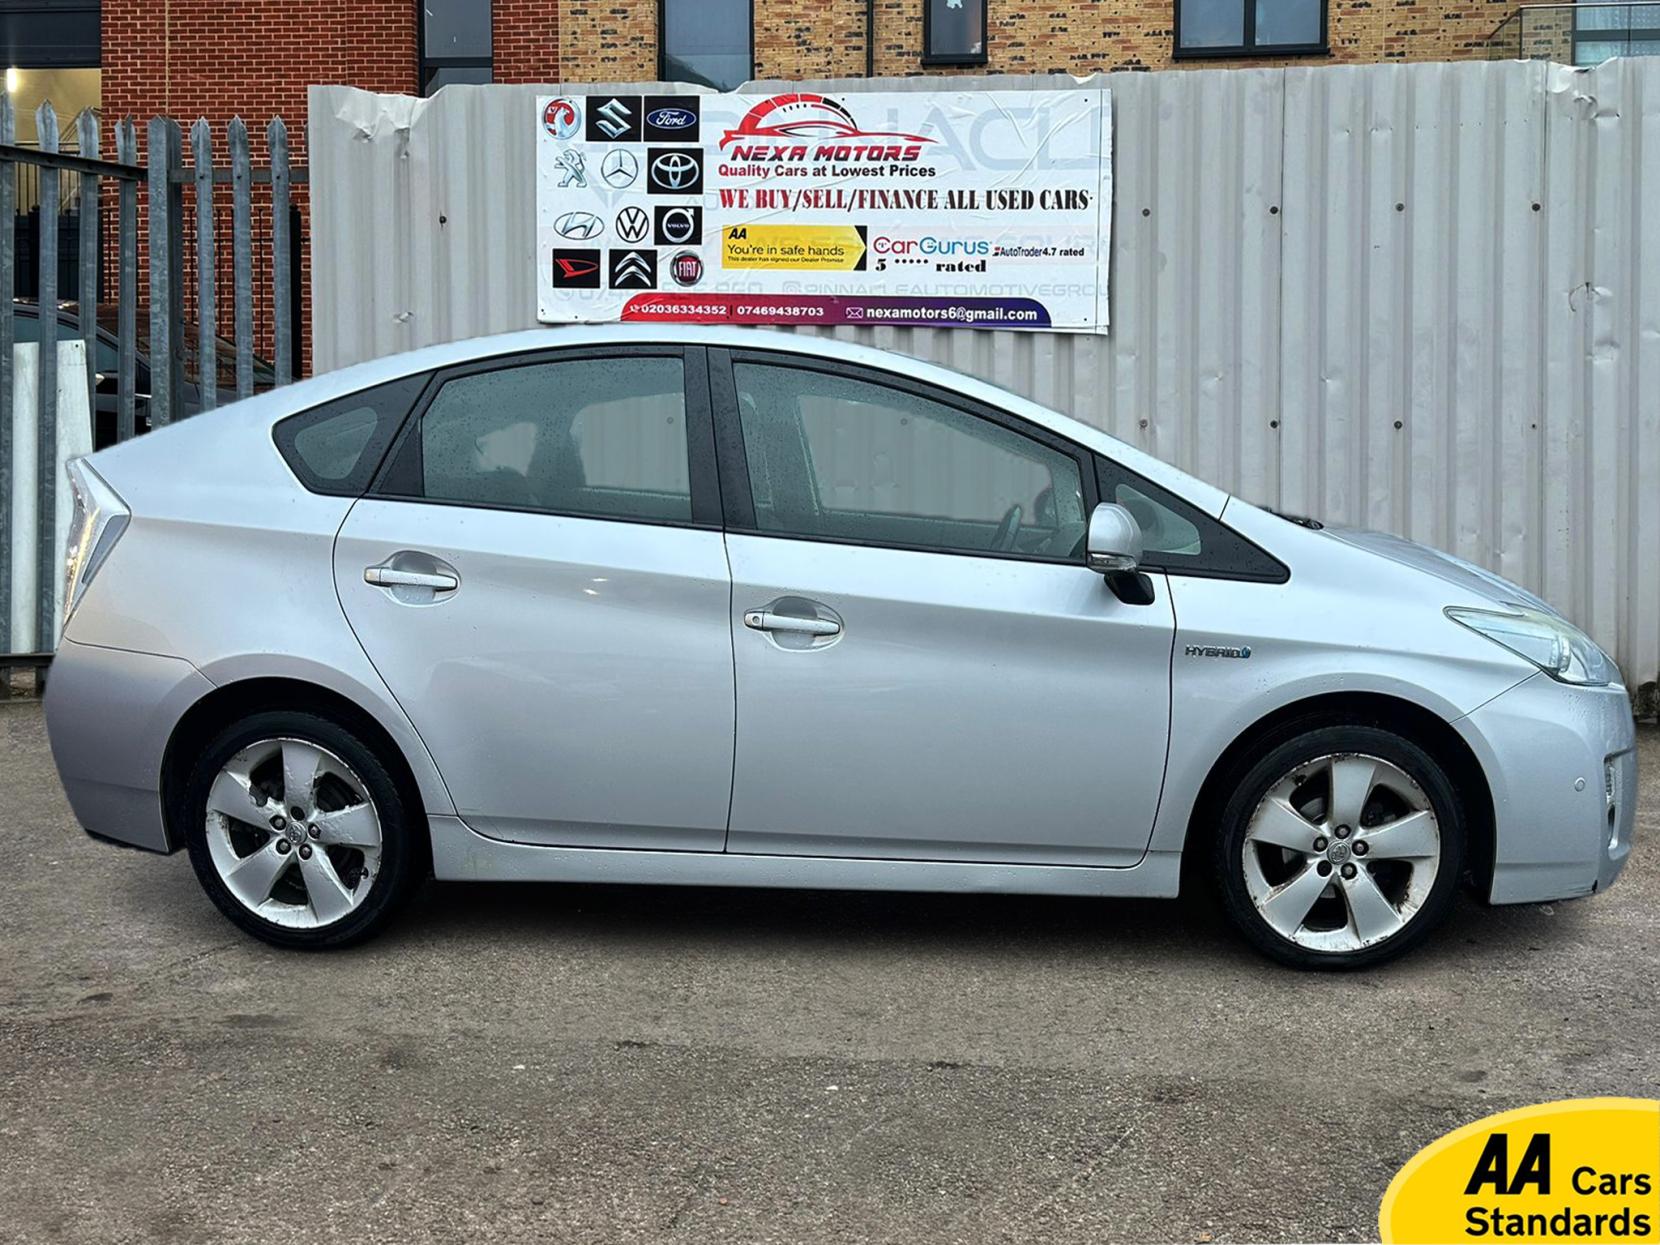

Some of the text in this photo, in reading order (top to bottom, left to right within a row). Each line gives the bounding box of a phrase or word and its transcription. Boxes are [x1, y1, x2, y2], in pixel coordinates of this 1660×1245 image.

[656, 110, 687, 126] Ford
[731, 146, 922, 161] NEXA MOTORS
[719, 164, 936, 179] Quality Cars at Lowest Prices
[719, 189, 749, 208] WE
[756, 189, 938, 212] BUY/SELL/FINANCE
[944, 190, 979, 210] ALL
[986, 189, 1034, 210] USED
[1040, 189, 1089, 210] CARS
[728, 228, 747, 239] AA
[728, 244, 844, 256] You're in safe hands
[873, 236, 989, 255] CarGurus
[1059, 247, 1085, 257] rated
[678, 262, 697, 277] FIAT
[875, 258, 986, 272] 5 rated
[641, 304, 824, 316] 02036334352 07469438703
[866, 306, 1037, 322] nexamotors6@gmail.com
[1185, 645, 1241, 658] HYBRID
